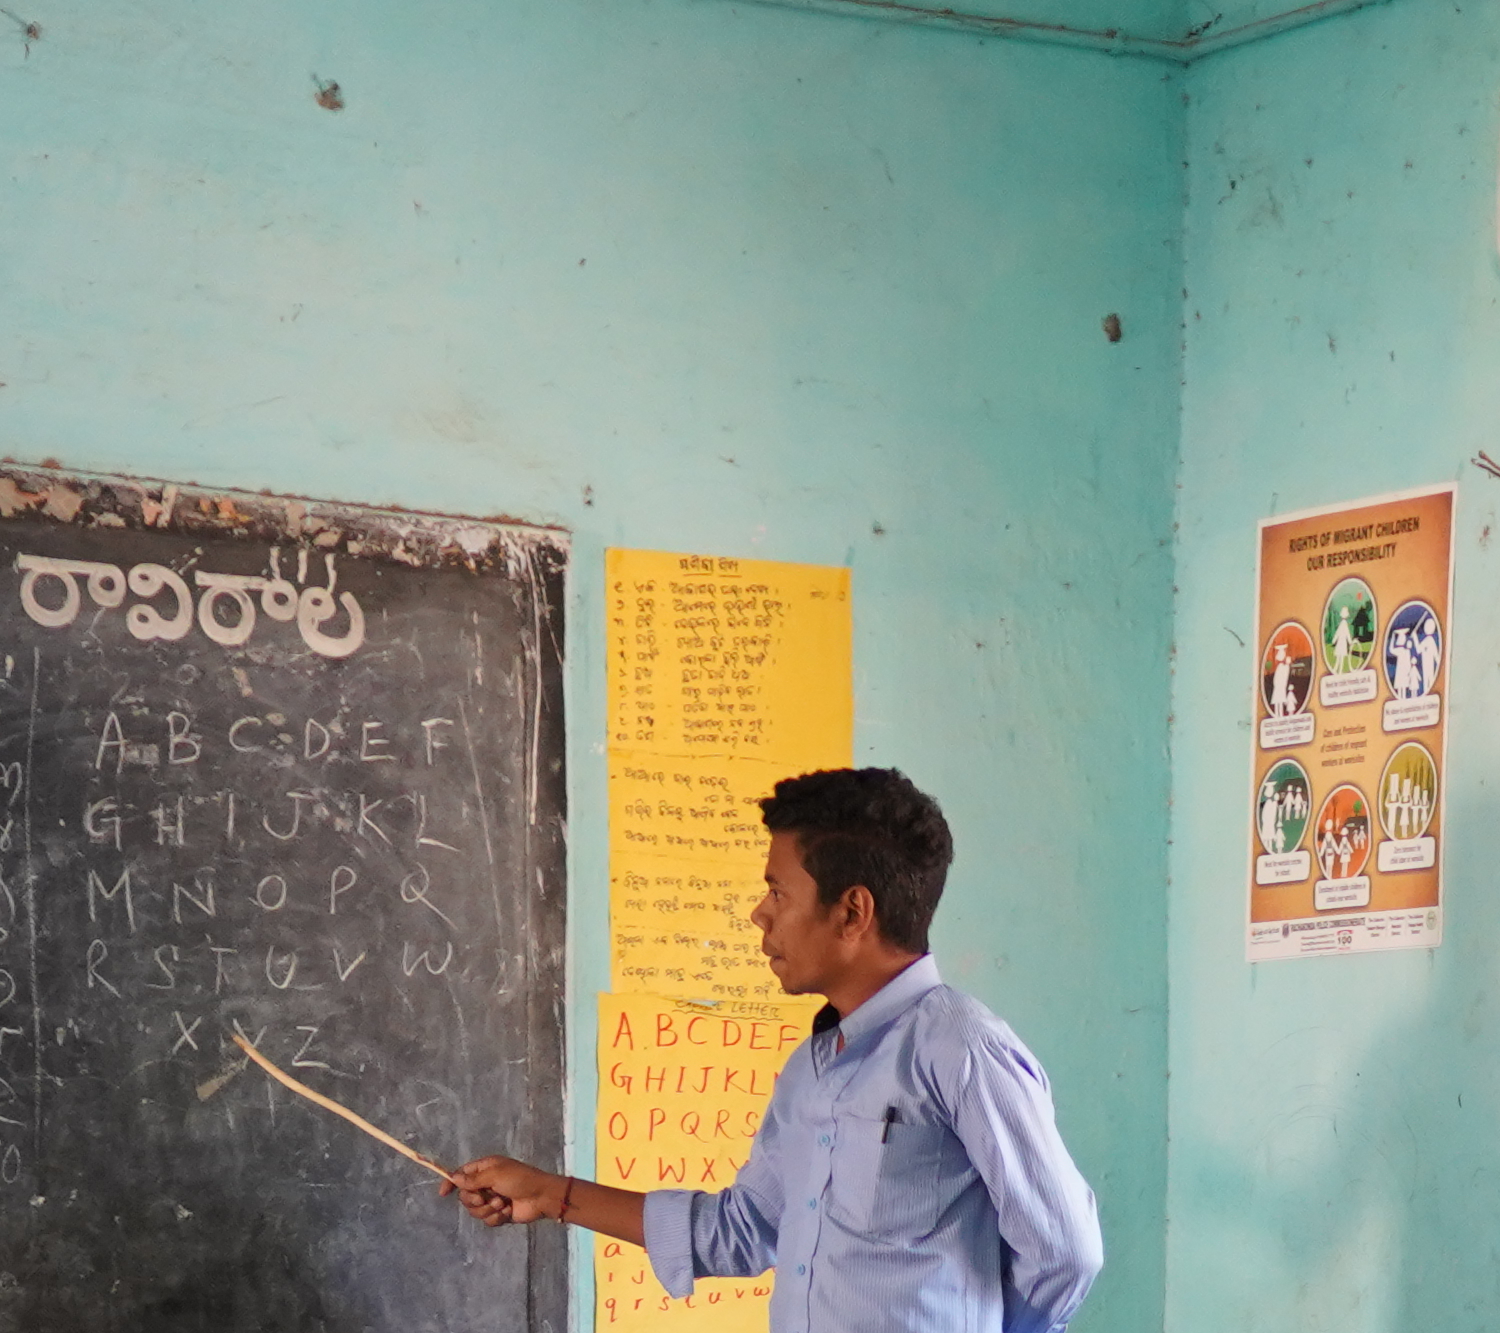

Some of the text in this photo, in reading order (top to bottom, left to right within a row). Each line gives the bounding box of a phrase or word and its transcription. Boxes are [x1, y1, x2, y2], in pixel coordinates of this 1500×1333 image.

[1289, 515, 1421, 553] RIGHTS OF MIGRANT CHILDREN
[1307, 542, 1398, 571] OUR RESPONSIBILITY
[94, 711, 455, 775] A B C D E F
[83, 790, 462, 853] G H I J K L
[87, 861, 459, 934] M N O P Q
[1337, 935, 1353, 946] 100
[86, 938, 454, 999] R S T U V W
[171, 1010, 203, 1055] X
[290, 1025, 335, 1068] Z
[613, 1012, 801, 1051] A B C D E F
[610, 1062, 767, 1096] G H I J K L
[608, 1107, 759, 1143] O P Q R S
[615, 1156, 717, 1183] V W X
[604, 1242, 625, 1258] a
[605, 1298, 618, 1323] q
[708, 1291, 725, 1305] u
[752, 1286, 771, 1297] w
